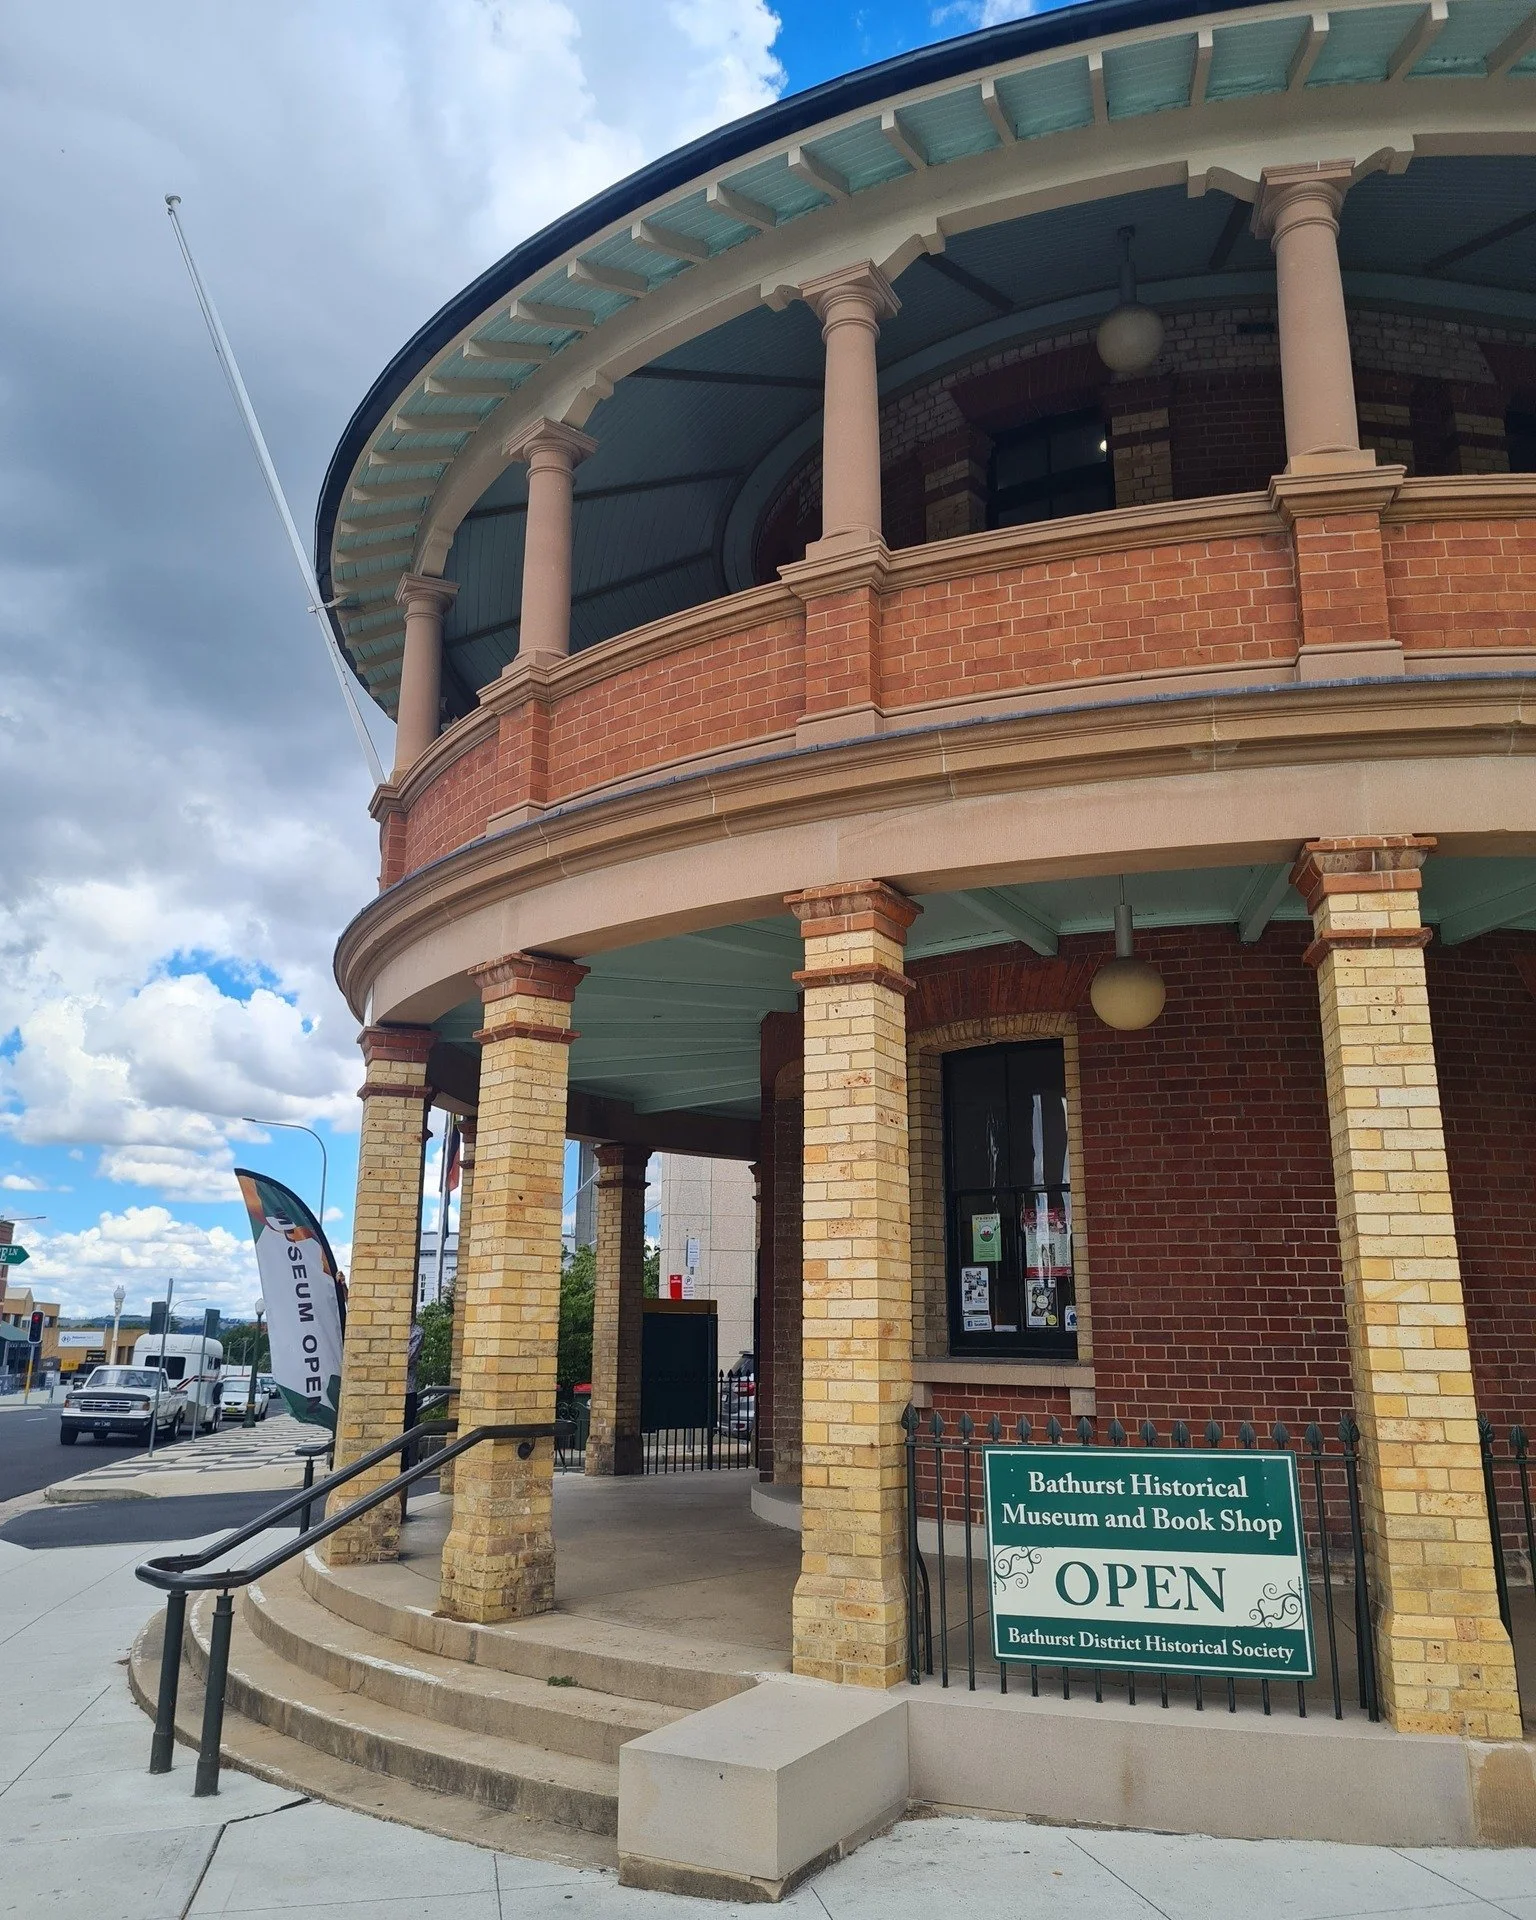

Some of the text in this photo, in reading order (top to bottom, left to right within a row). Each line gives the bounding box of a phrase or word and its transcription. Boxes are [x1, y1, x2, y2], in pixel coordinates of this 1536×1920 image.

[302, 1334, 323, 1414] OPEN
[1028, 1471, 1249, 1498] Bathurst Historical
[1001, 1502, 1283, 1541] Museum and Book Shop
[1055, 1560, 1226, 1613] OPEN
[1008, 1627, 1294, 1664] Bathurst District Historical Society
